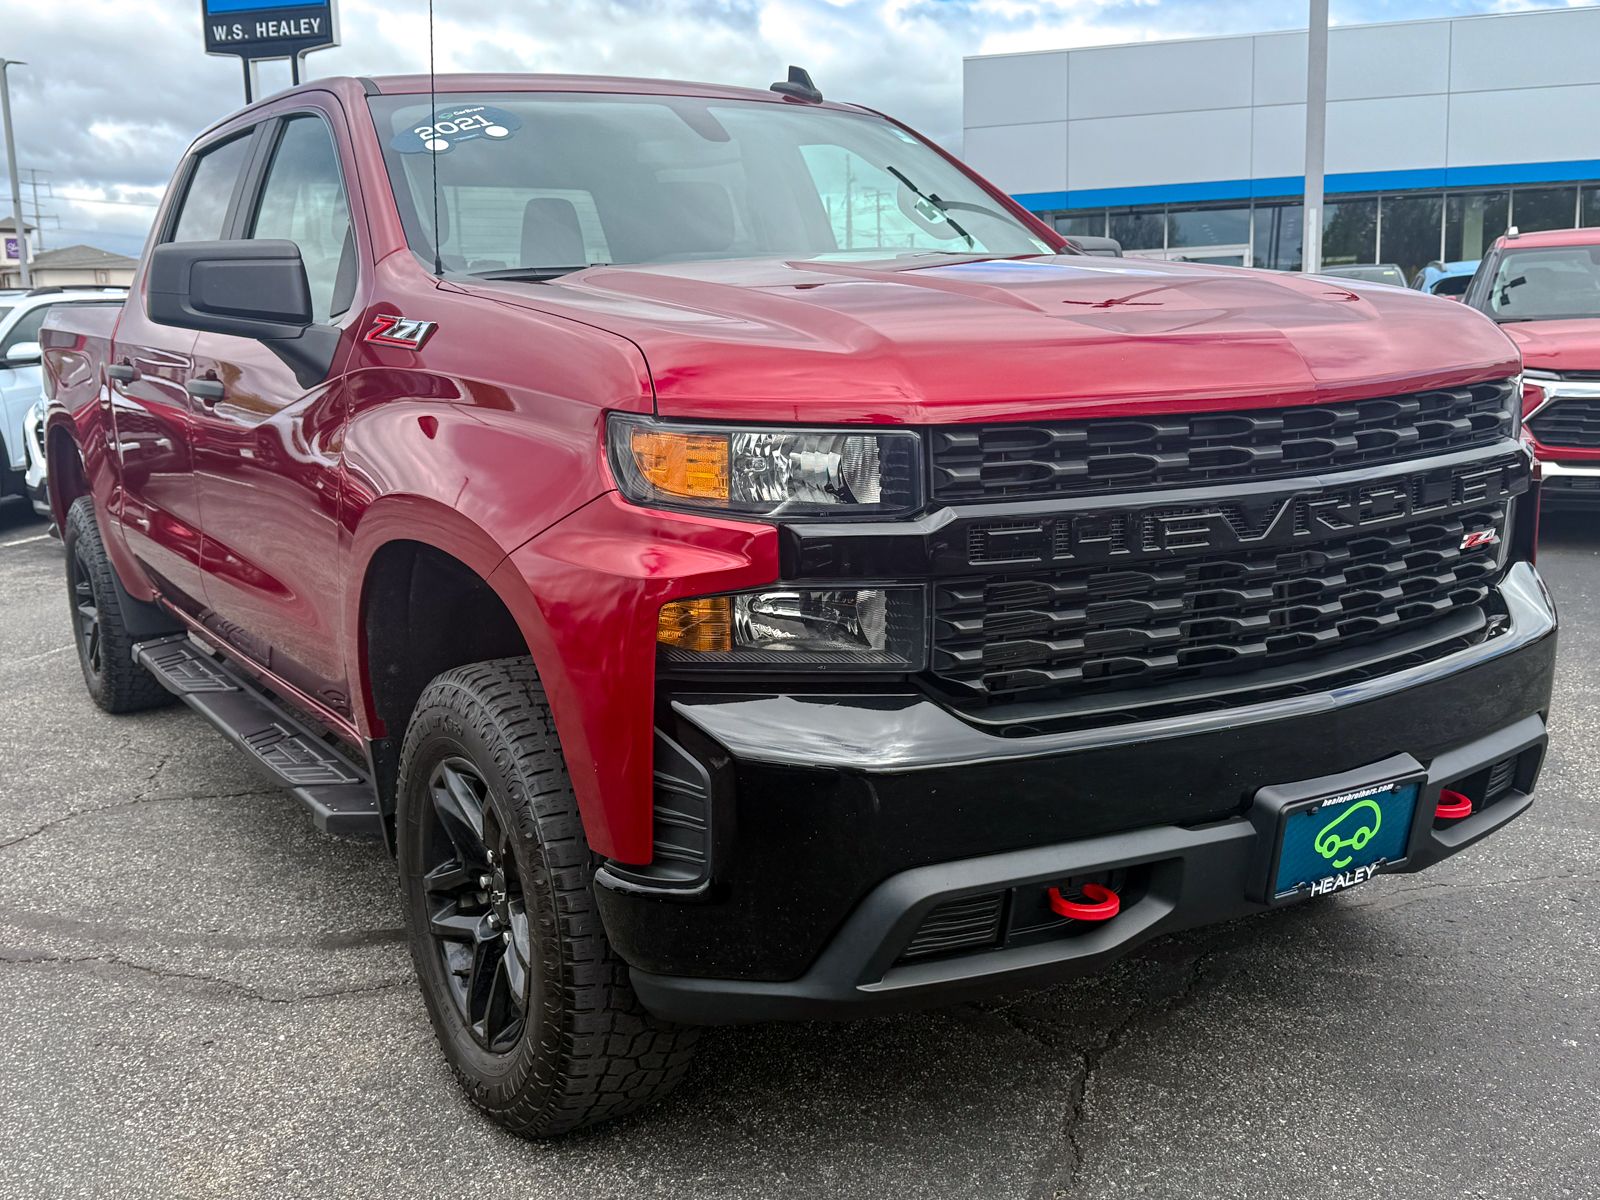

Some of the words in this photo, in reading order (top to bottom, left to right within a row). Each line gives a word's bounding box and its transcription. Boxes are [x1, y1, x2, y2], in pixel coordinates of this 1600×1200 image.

[213, 24, 249, 41] W.S.
[255, 18, 320, 38] HEALEY
[414, 115, 494, 140] 2021
[363, 313, 439, 352] Z71
[967, 453, 1521, 566] CHEVROLET
[1321, 783, 1394, 808] healeybrothers.com
[1310, 864, 1377, 898] HEALEY
